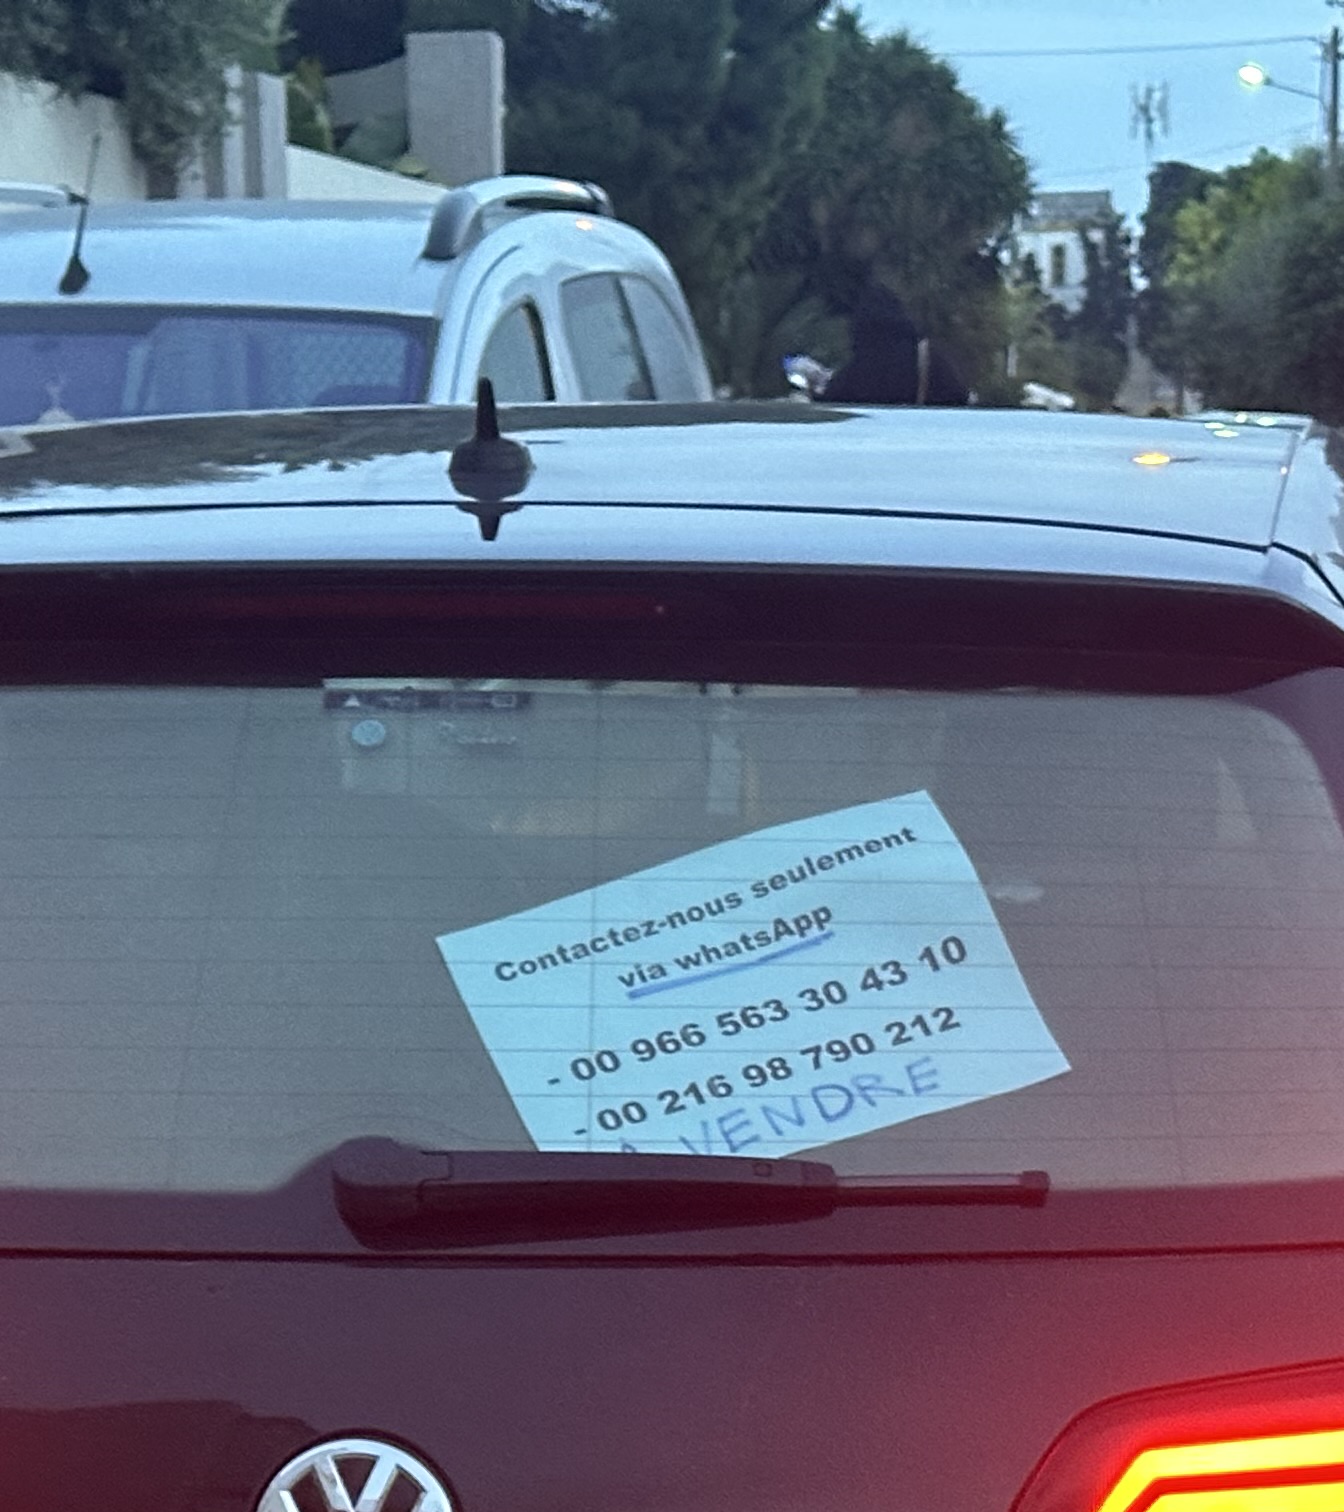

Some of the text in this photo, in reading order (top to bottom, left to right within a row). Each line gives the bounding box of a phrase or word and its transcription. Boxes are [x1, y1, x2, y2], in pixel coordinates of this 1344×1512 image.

[494, 826, 917, 982] Contactez-nous seulement
[617, 904, 833, 989] via whatsApp
[570, 1049, 621, 1083] 00
[631, 1022, 708, 1064] 966
[716, 998, 790, 1038] 563
[798, 979, 848, 1014] 30
[859, 959, 908, 995] 43
[918, 934, 968, 974] 10
[597, 1101, 648, 1133] 00
[659, 1073, 734, 1114] 216
[741, 1055, 793, 1089] 98
[800, 1031, 876, 1072] 790
[885, 1005, 961, 1047] 212
[678, 1055, 941, 1156] VENDRE
